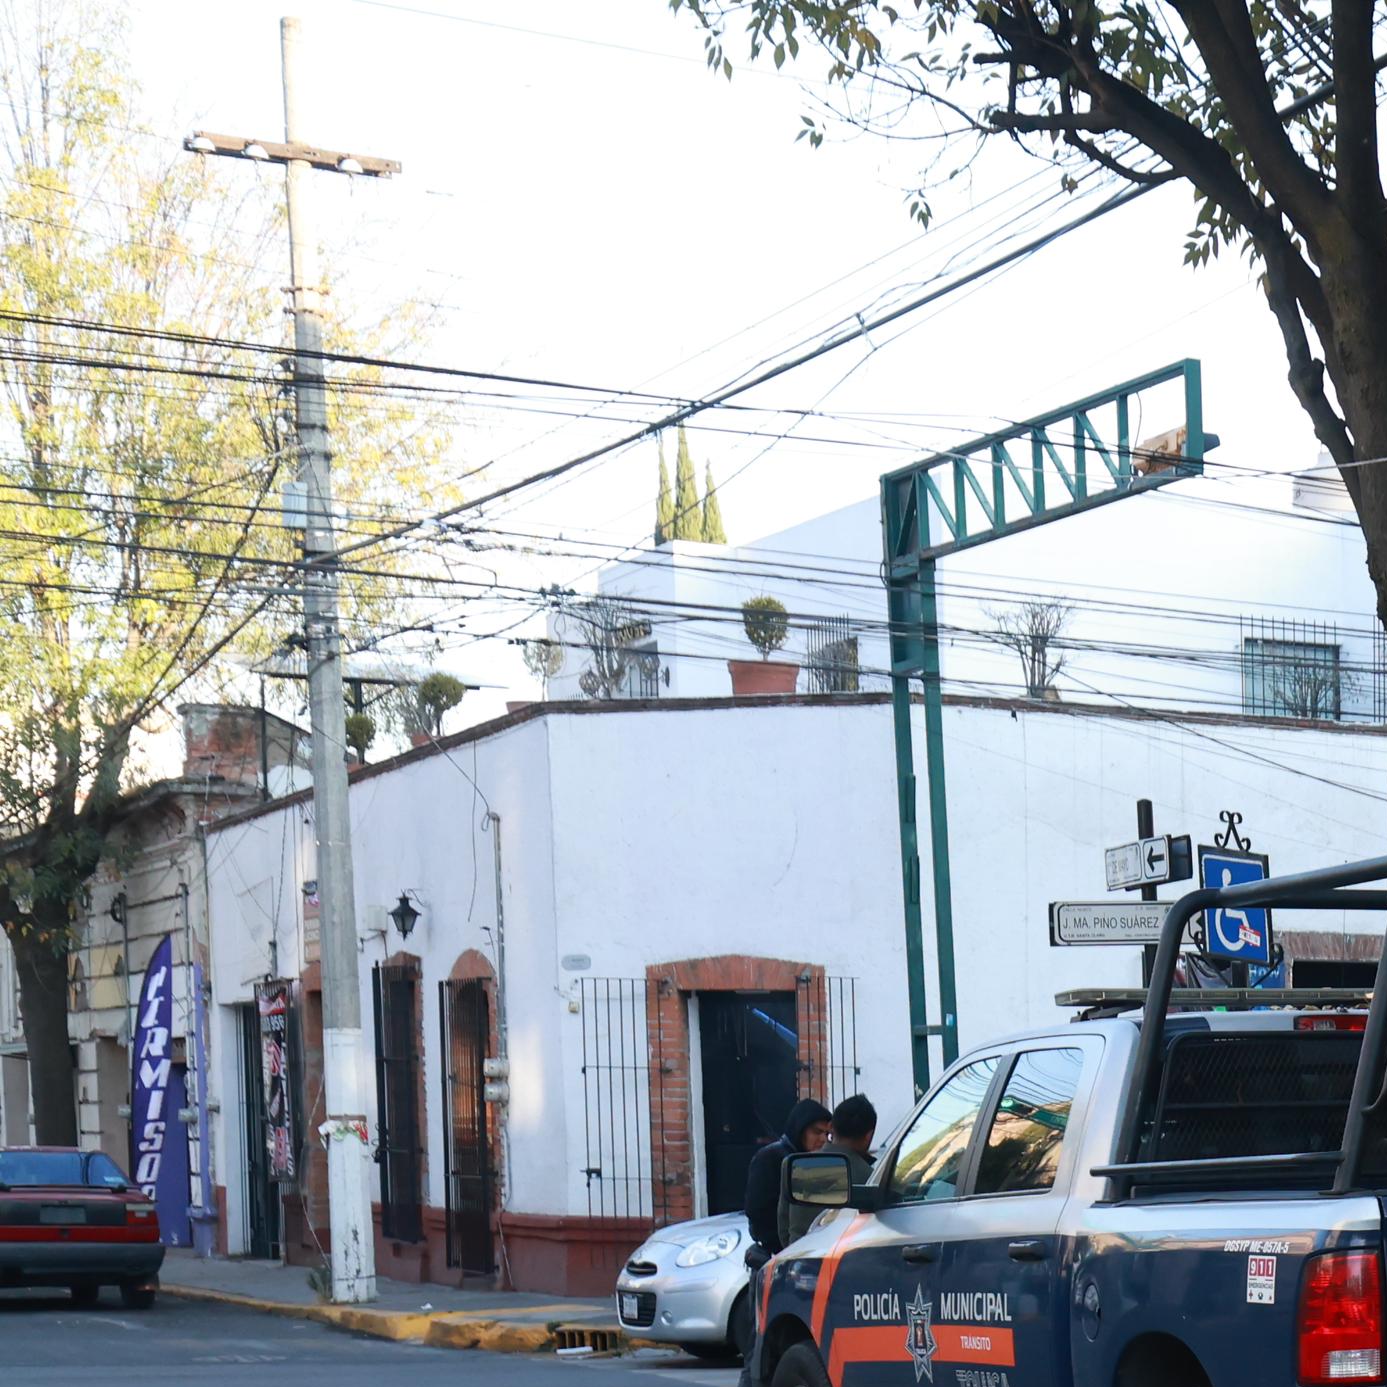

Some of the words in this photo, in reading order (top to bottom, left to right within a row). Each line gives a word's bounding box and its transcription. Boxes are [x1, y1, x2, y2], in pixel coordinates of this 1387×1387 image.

[1063, 918, 1071, 929] J.
[1073, 918, 1091, 929] MA.
[1120, 914, 1159, 929] SUÁREZ
[1224, 1240, 1249, 1252] DGSYP
[1250, 1260, 1273, 1275] 911
[854, 1288, 901, 1320] POLICÍA
[940, 1292, 1012, 1321] MUNICIPAL
[960, 1335, 991, 1350] TRÁNSITO
